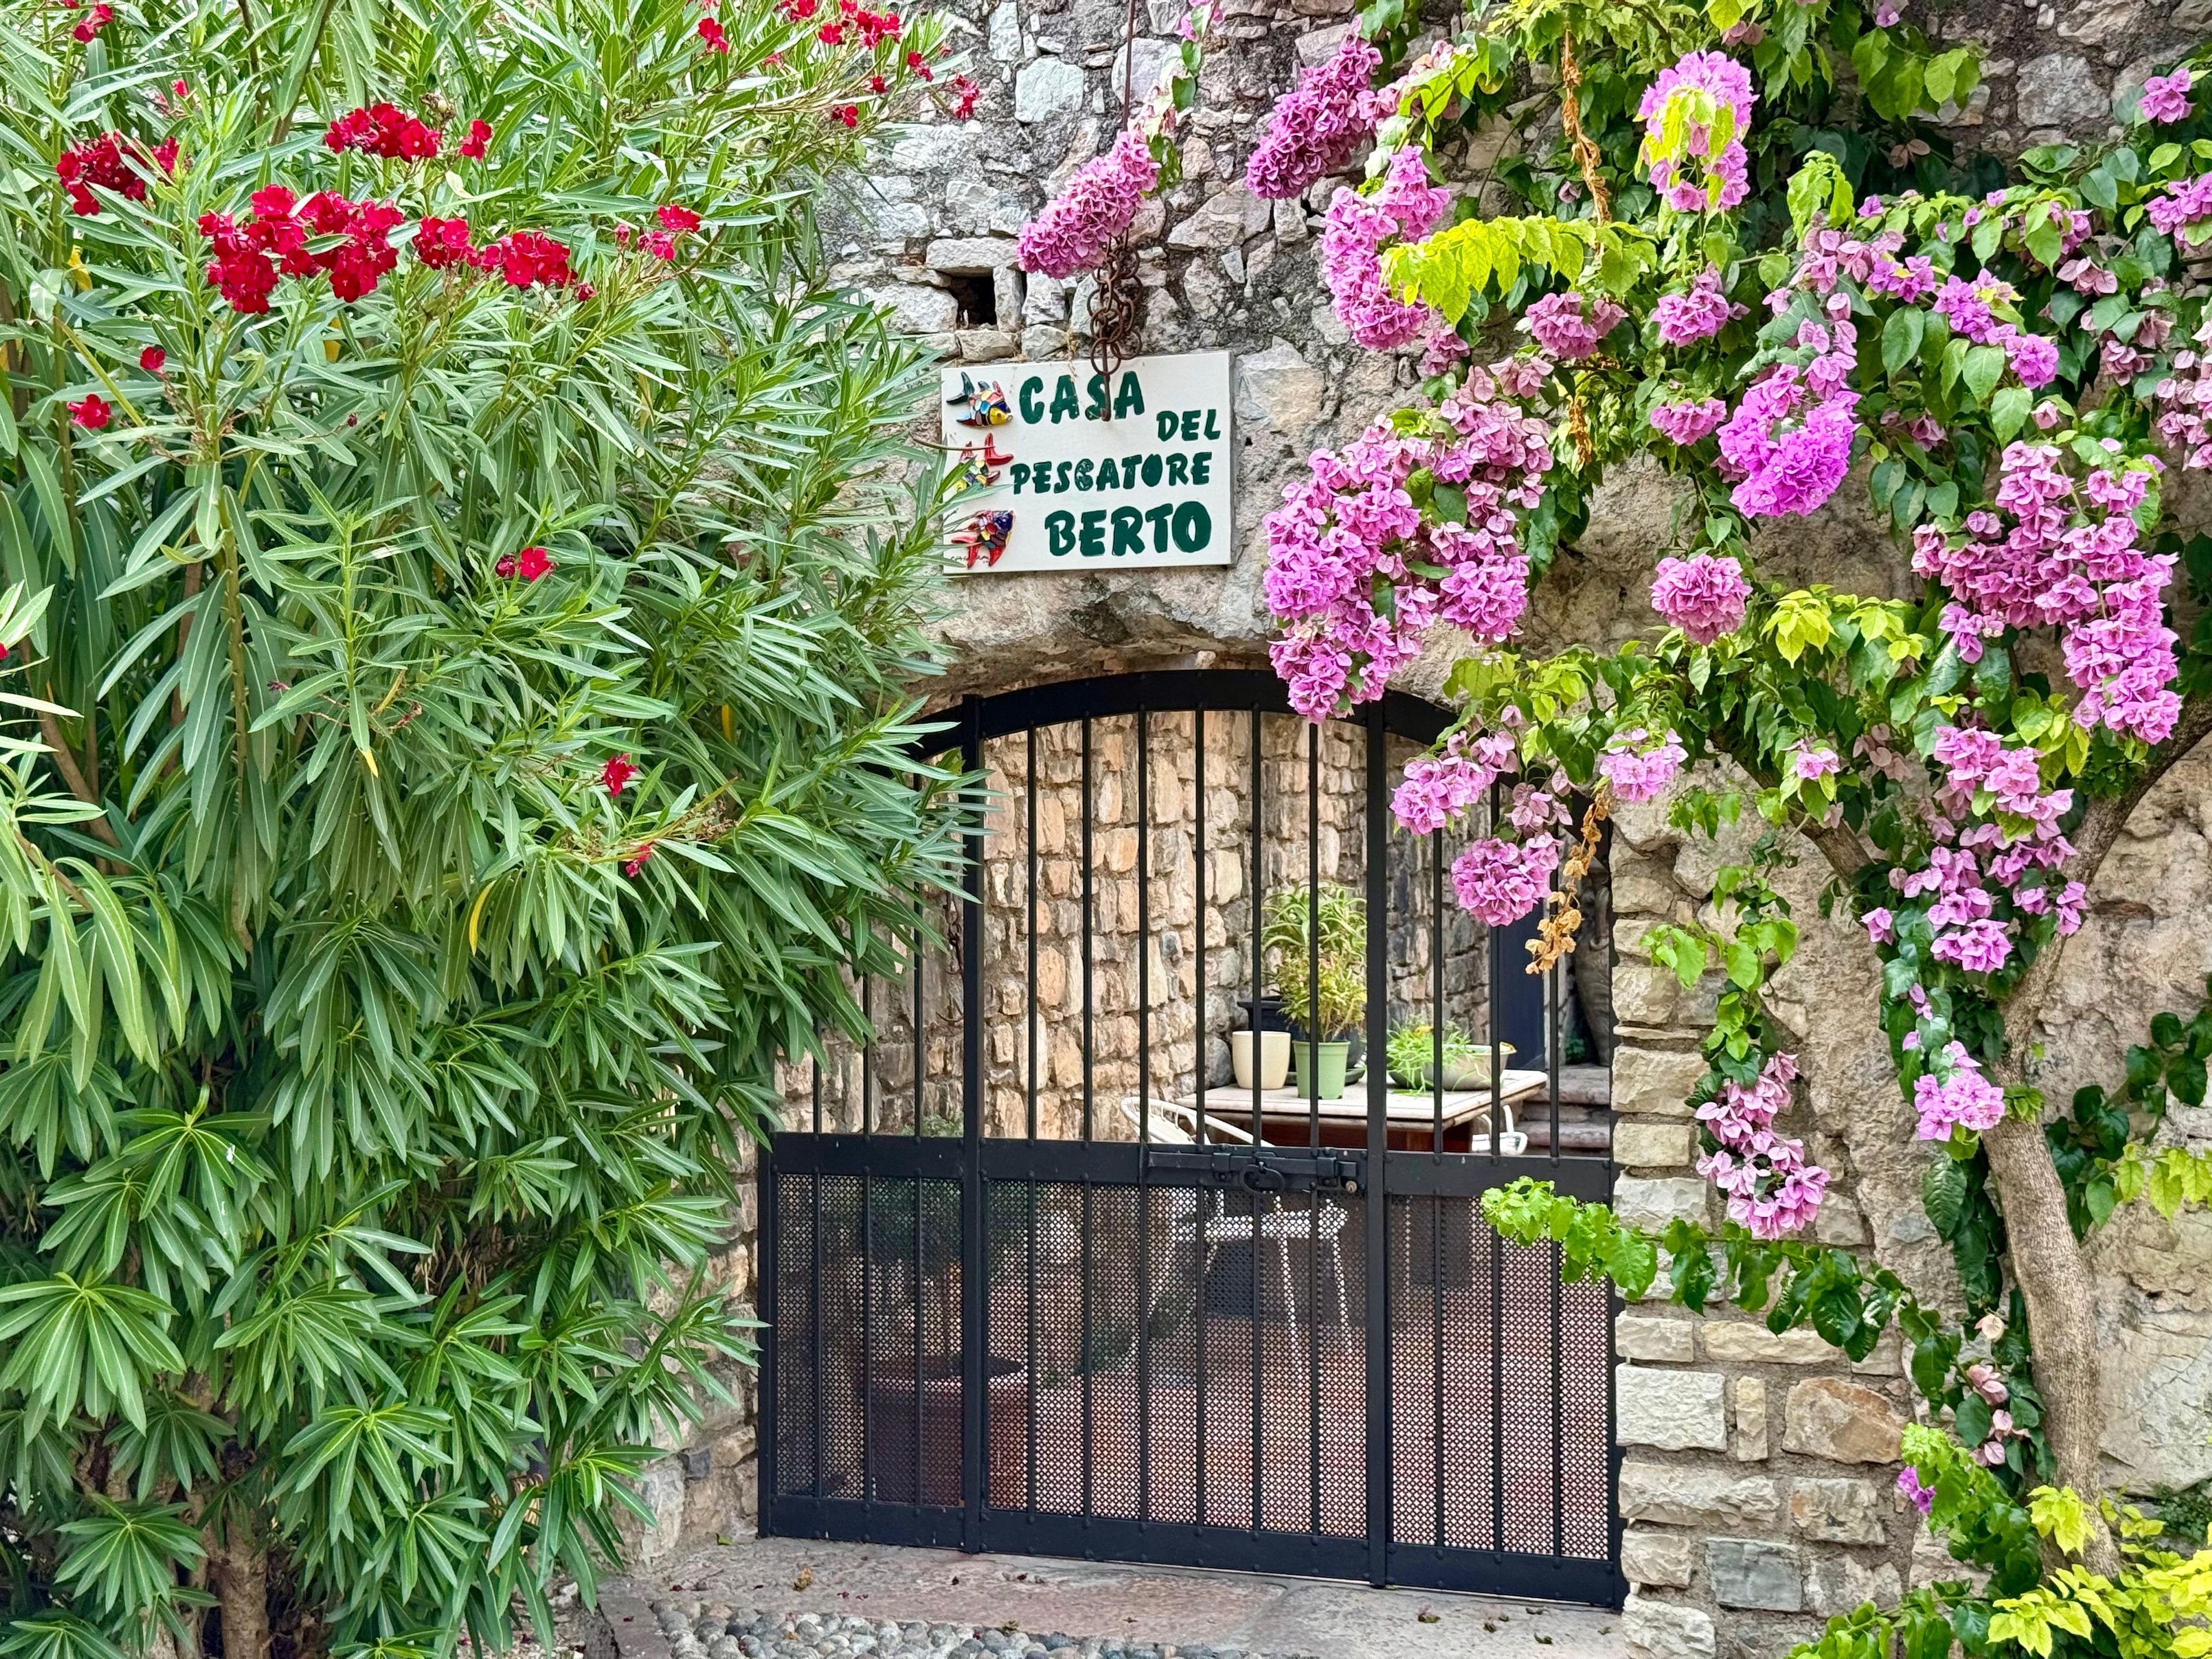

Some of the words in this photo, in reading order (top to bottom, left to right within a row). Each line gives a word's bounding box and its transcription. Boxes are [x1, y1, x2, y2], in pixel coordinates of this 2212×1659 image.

[1019, 371, 1145, 424] CASA
[1157, 408, 1221, 442] DEL
[1010, 452, 1212, 494] PESCATORE
[1044, 501, 1211, 556] BERTO
